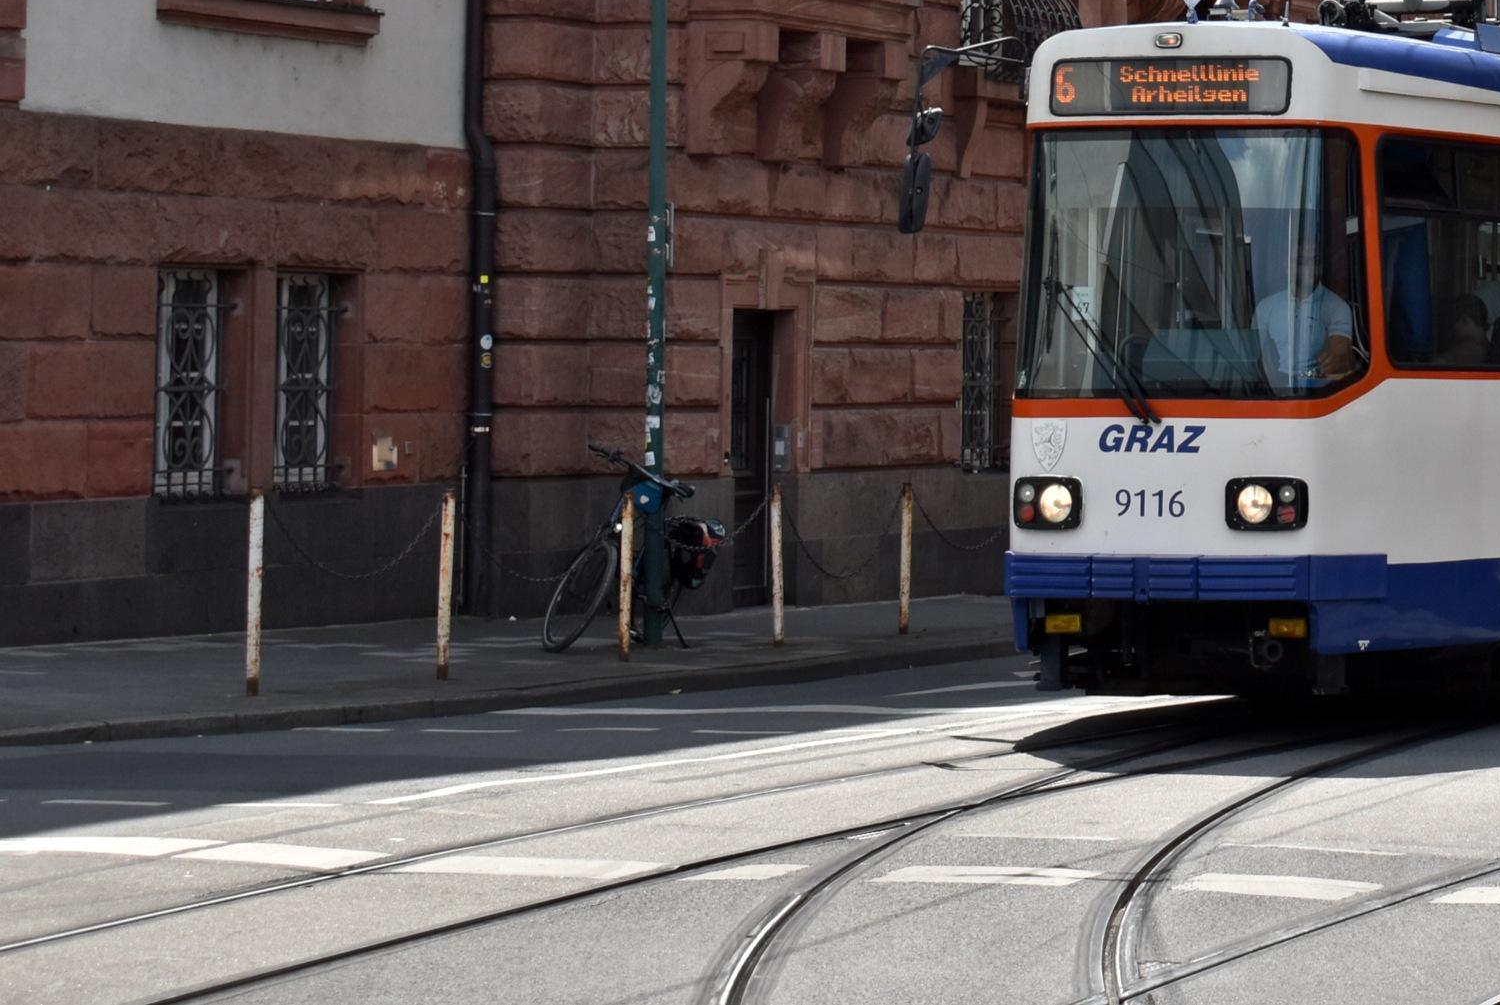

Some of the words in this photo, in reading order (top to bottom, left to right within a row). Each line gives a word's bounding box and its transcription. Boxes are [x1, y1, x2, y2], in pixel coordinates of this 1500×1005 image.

[1055, 67, 1076, 103] 6
[1120, 65, 1260, 83] Schnelllinie
[1099, 424, 1206, 453] GRAZ
[1115, 489, 1185, 517] 9116
